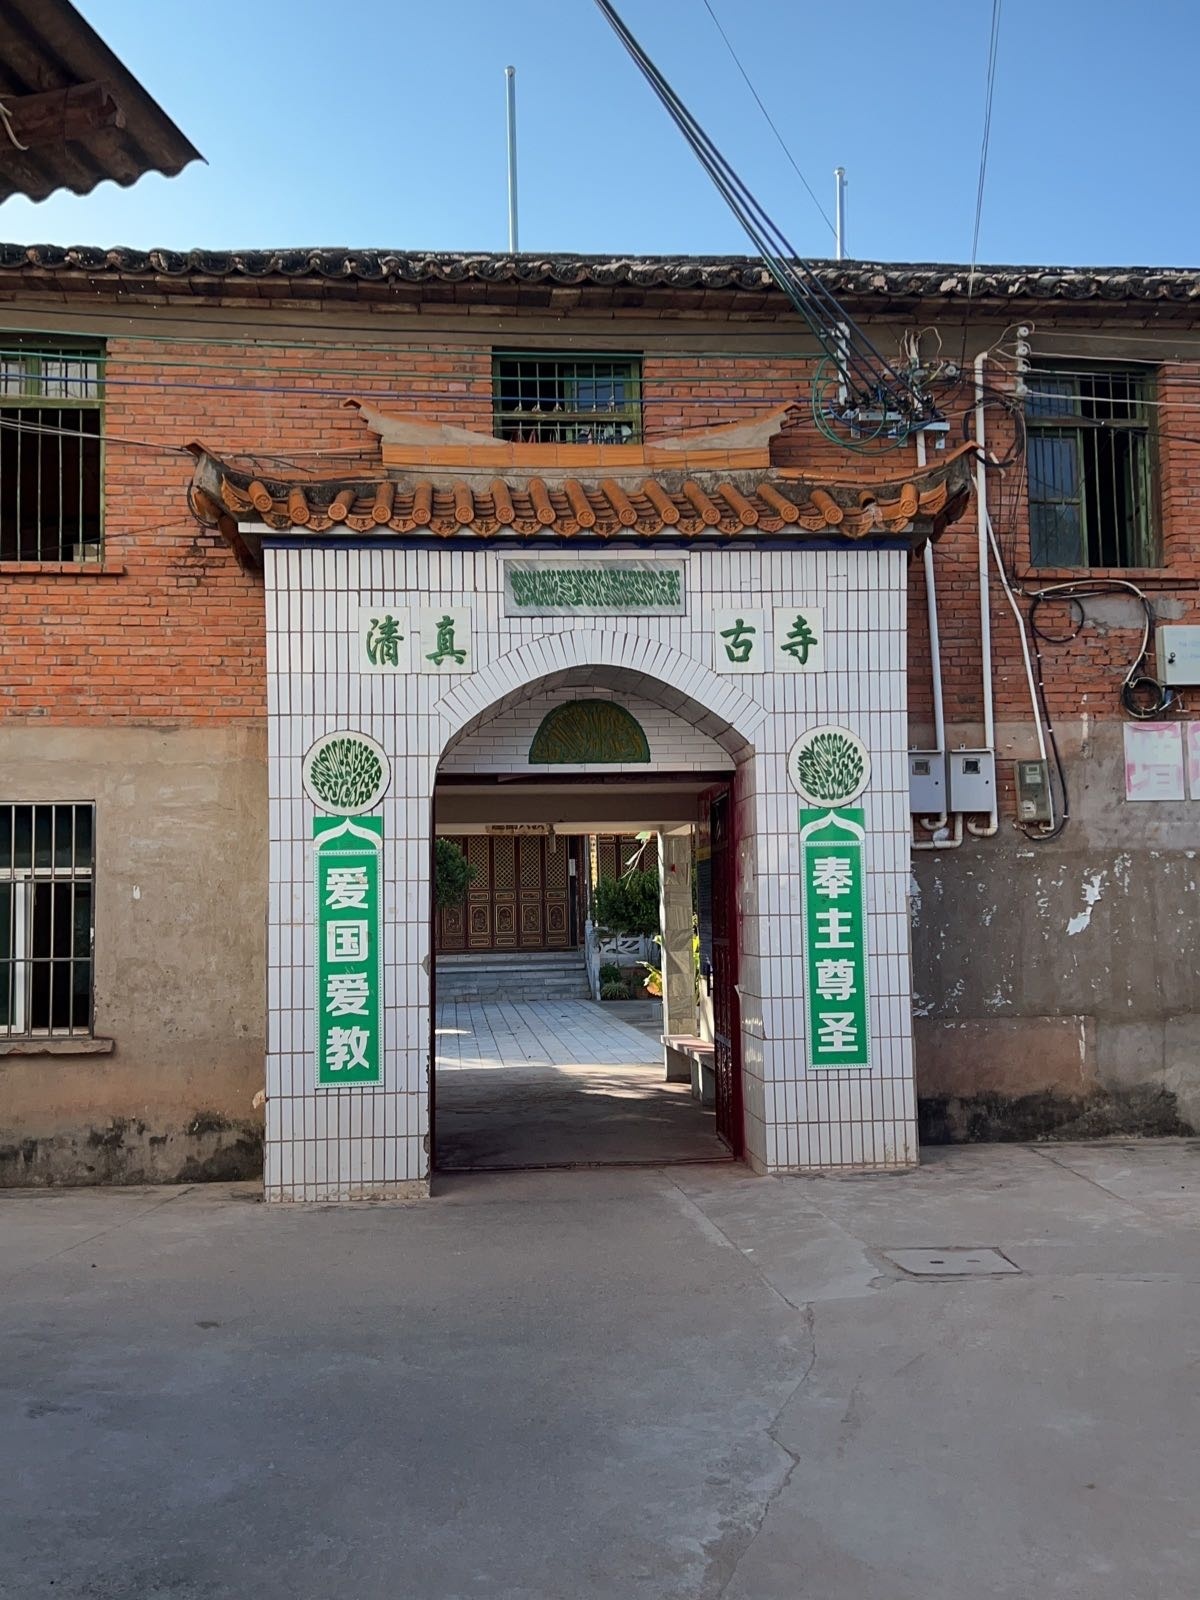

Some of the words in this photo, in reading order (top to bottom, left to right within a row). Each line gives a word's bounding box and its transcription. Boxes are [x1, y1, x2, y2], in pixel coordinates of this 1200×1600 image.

[366, 615, 467, 667] 清真
[719, 615, 818, 665] 古寺
[325, 866, 370, 1071] 爱国爱教
[812, 856, 859, 1053] 奉主尊圣
